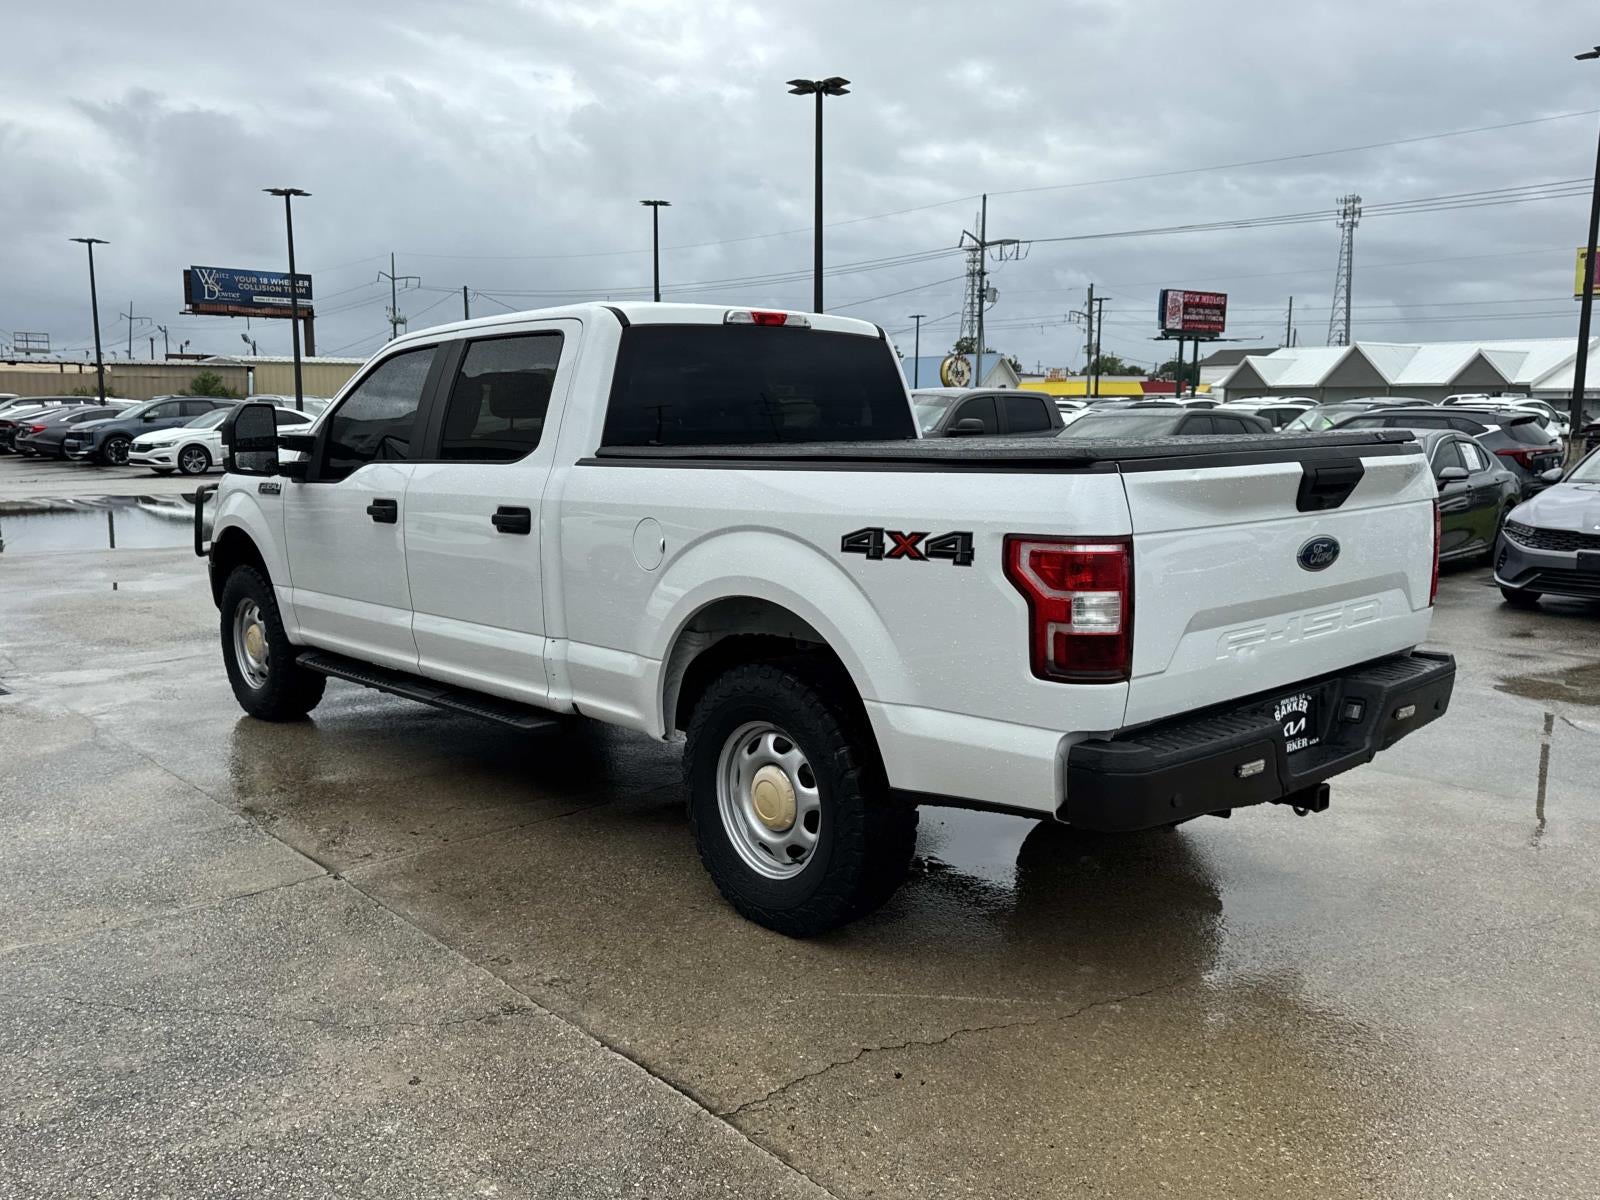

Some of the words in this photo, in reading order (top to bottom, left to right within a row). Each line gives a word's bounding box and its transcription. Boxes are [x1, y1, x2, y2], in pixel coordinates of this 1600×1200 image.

[233, 275, 257, 284] YOUR
[271, 279, 310, 288] WHELER
[238, 283, 282, 293] COLLISION
[1216, 599, 1382, 661] F-150
[1286, 738, 1308, 753] RKER
